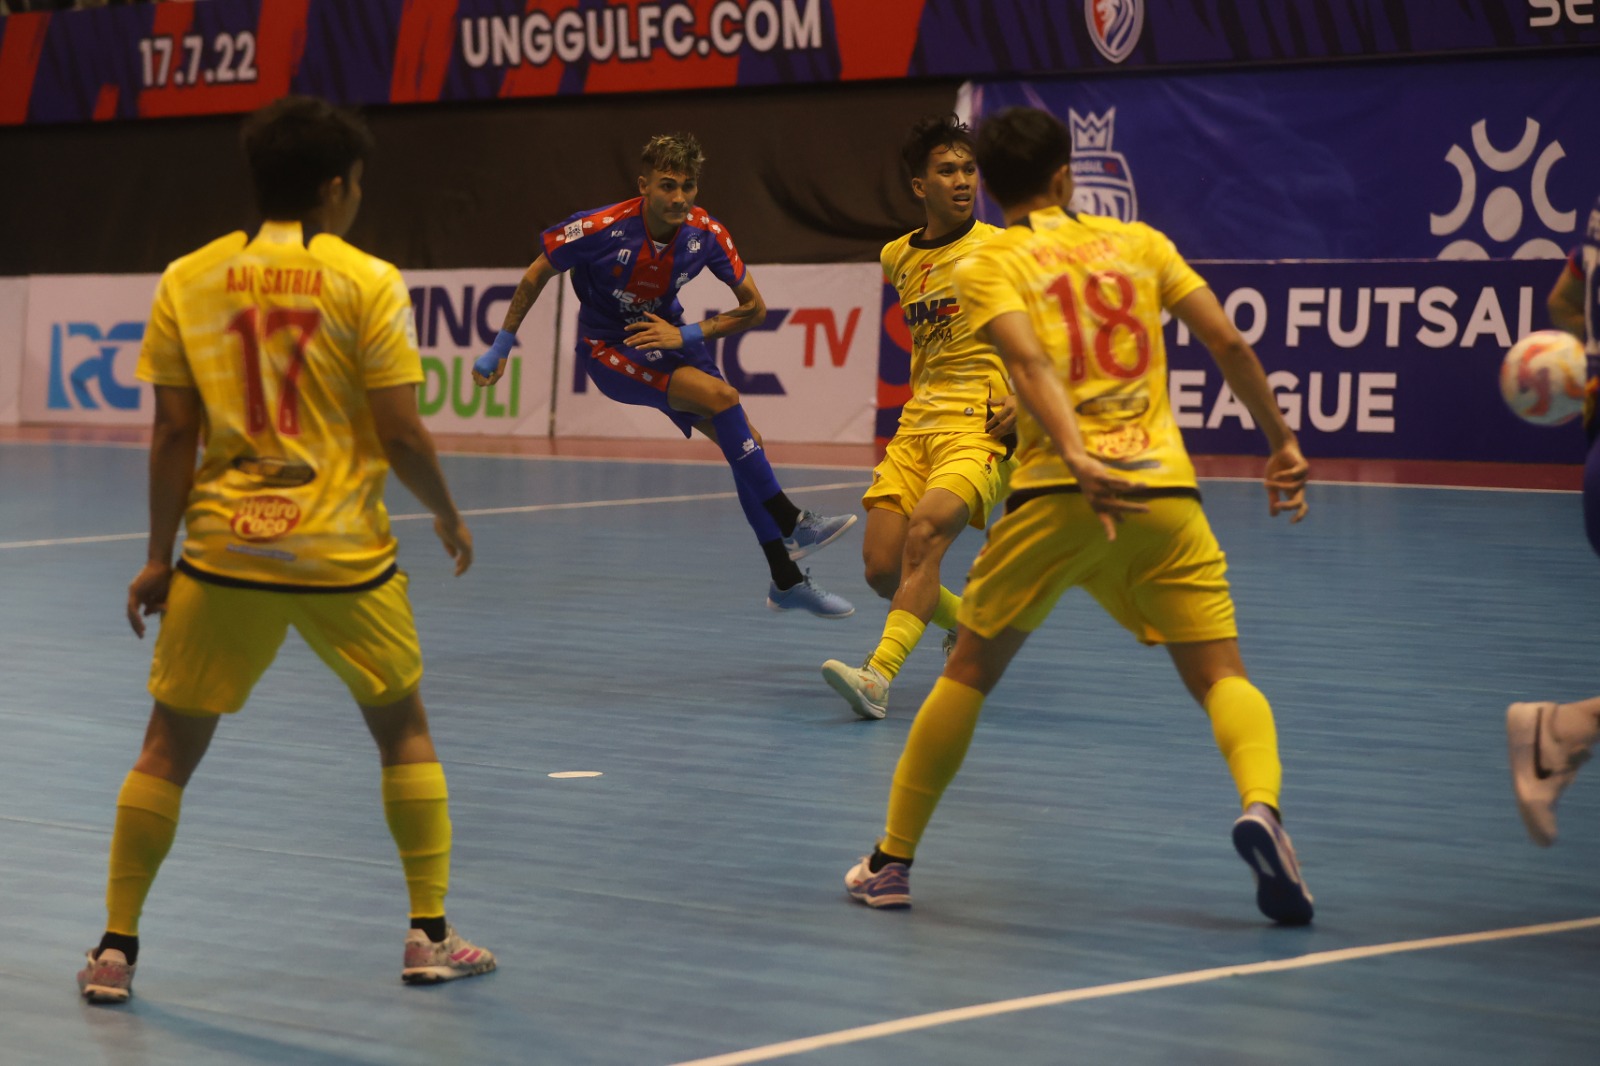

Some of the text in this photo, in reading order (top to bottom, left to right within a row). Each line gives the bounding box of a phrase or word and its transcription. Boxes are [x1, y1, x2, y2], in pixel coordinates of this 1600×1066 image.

[140, 31, 257, 86] 17.7.22
[461, 0, 822, 67] UNGGULFC.COM
[617, 249, 631, 265] 10
[921, 264, 934, 294] 7
[1044, 269, 1151, 384] 18
[227, 306, 323, 436] 17
[418, 355, 522, 418] DULI
[1169, 370, 1397, 433] EAGUE
